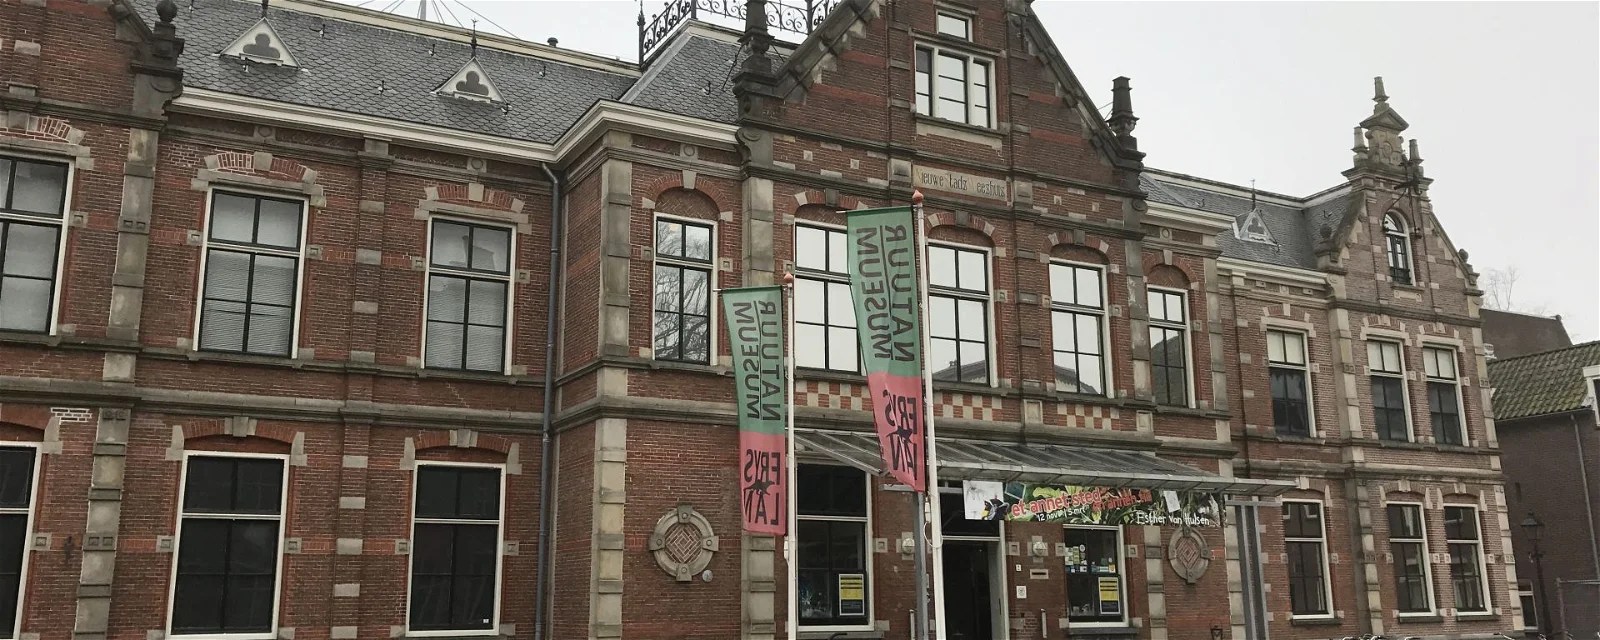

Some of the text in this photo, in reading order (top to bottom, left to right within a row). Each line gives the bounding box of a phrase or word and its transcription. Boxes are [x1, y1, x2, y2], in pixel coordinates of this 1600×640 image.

[1030, 492, 1069, 513] annet
[1072, 487, 1101, 507] sted
[1037, 513, 1046, 522] 12
[1137, 512, 1166, 525] Esther
